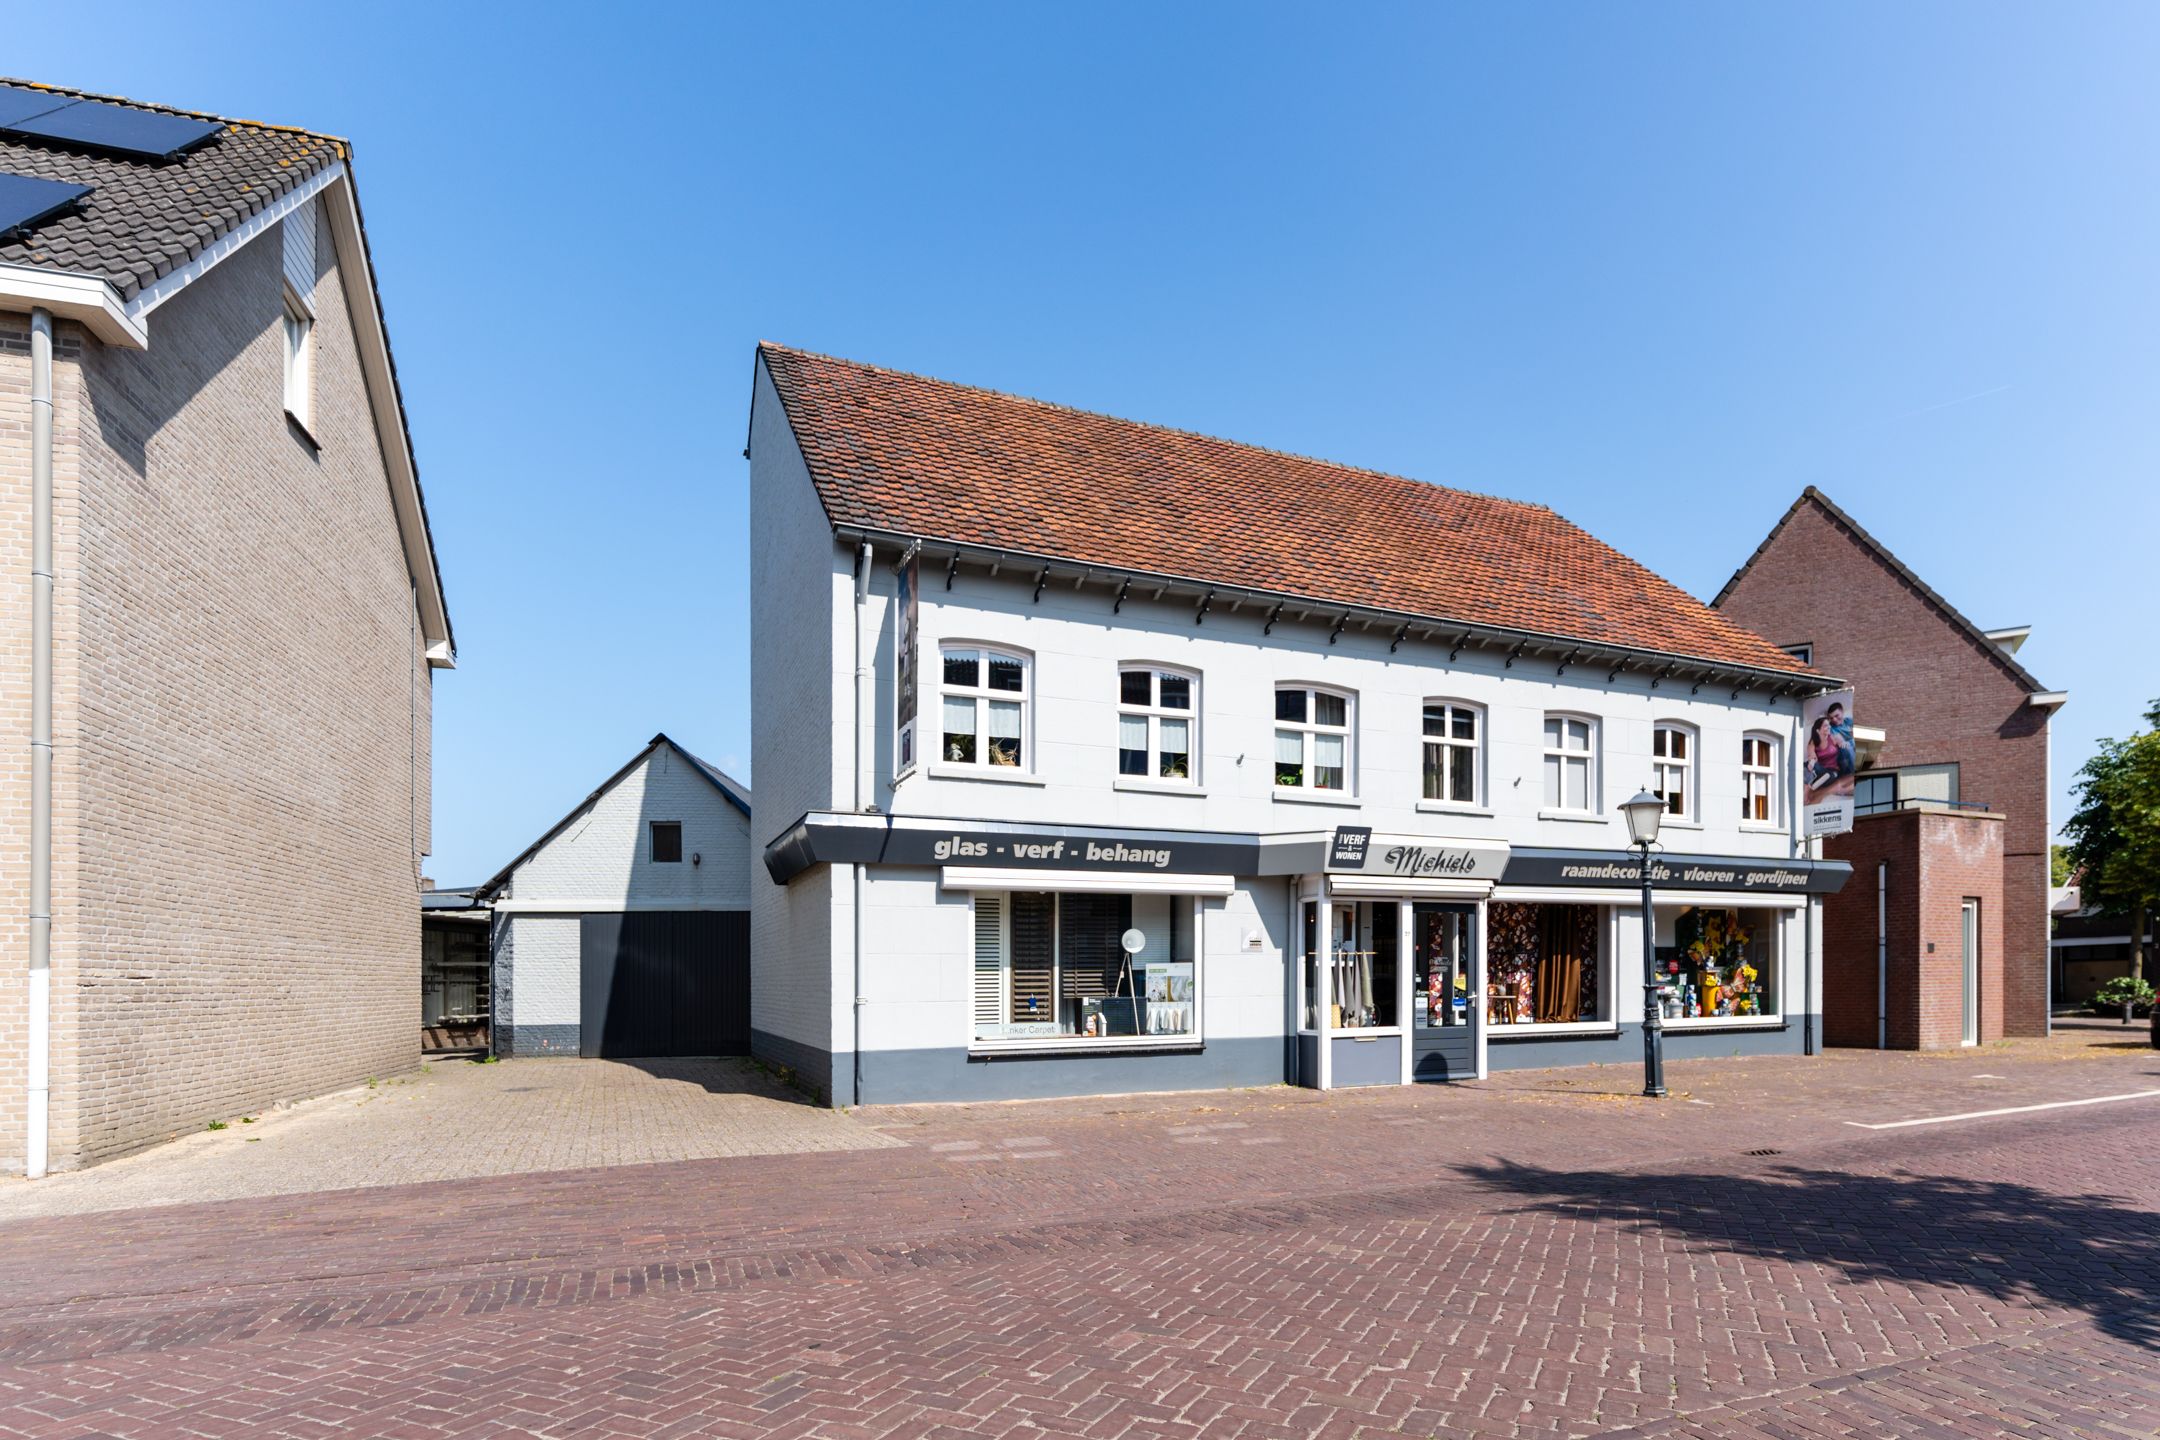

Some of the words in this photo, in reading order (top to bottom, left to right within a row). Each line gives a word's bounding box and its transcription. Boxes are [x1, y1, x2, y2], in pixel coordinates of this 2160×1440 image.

[1813, 815, 1842, 825] sikkens
[1343, 834, 1367, 845] VERF
[934, 836, 989, 860] glas
[1013, 840, 1065, 860] verf
[1086, 842, 1171, 867] behang
[1335, 851, 1363, 860] WONEN
[1384, 846, 1476, 878] Michiels
[1561, 863, 1671, 881] raamdecortie
[1684, 866, 1736, 883] vloeren
[1744, 867, 1809, 888] gordijnen
[1028, 1025, 1055, 1036] Carpet
